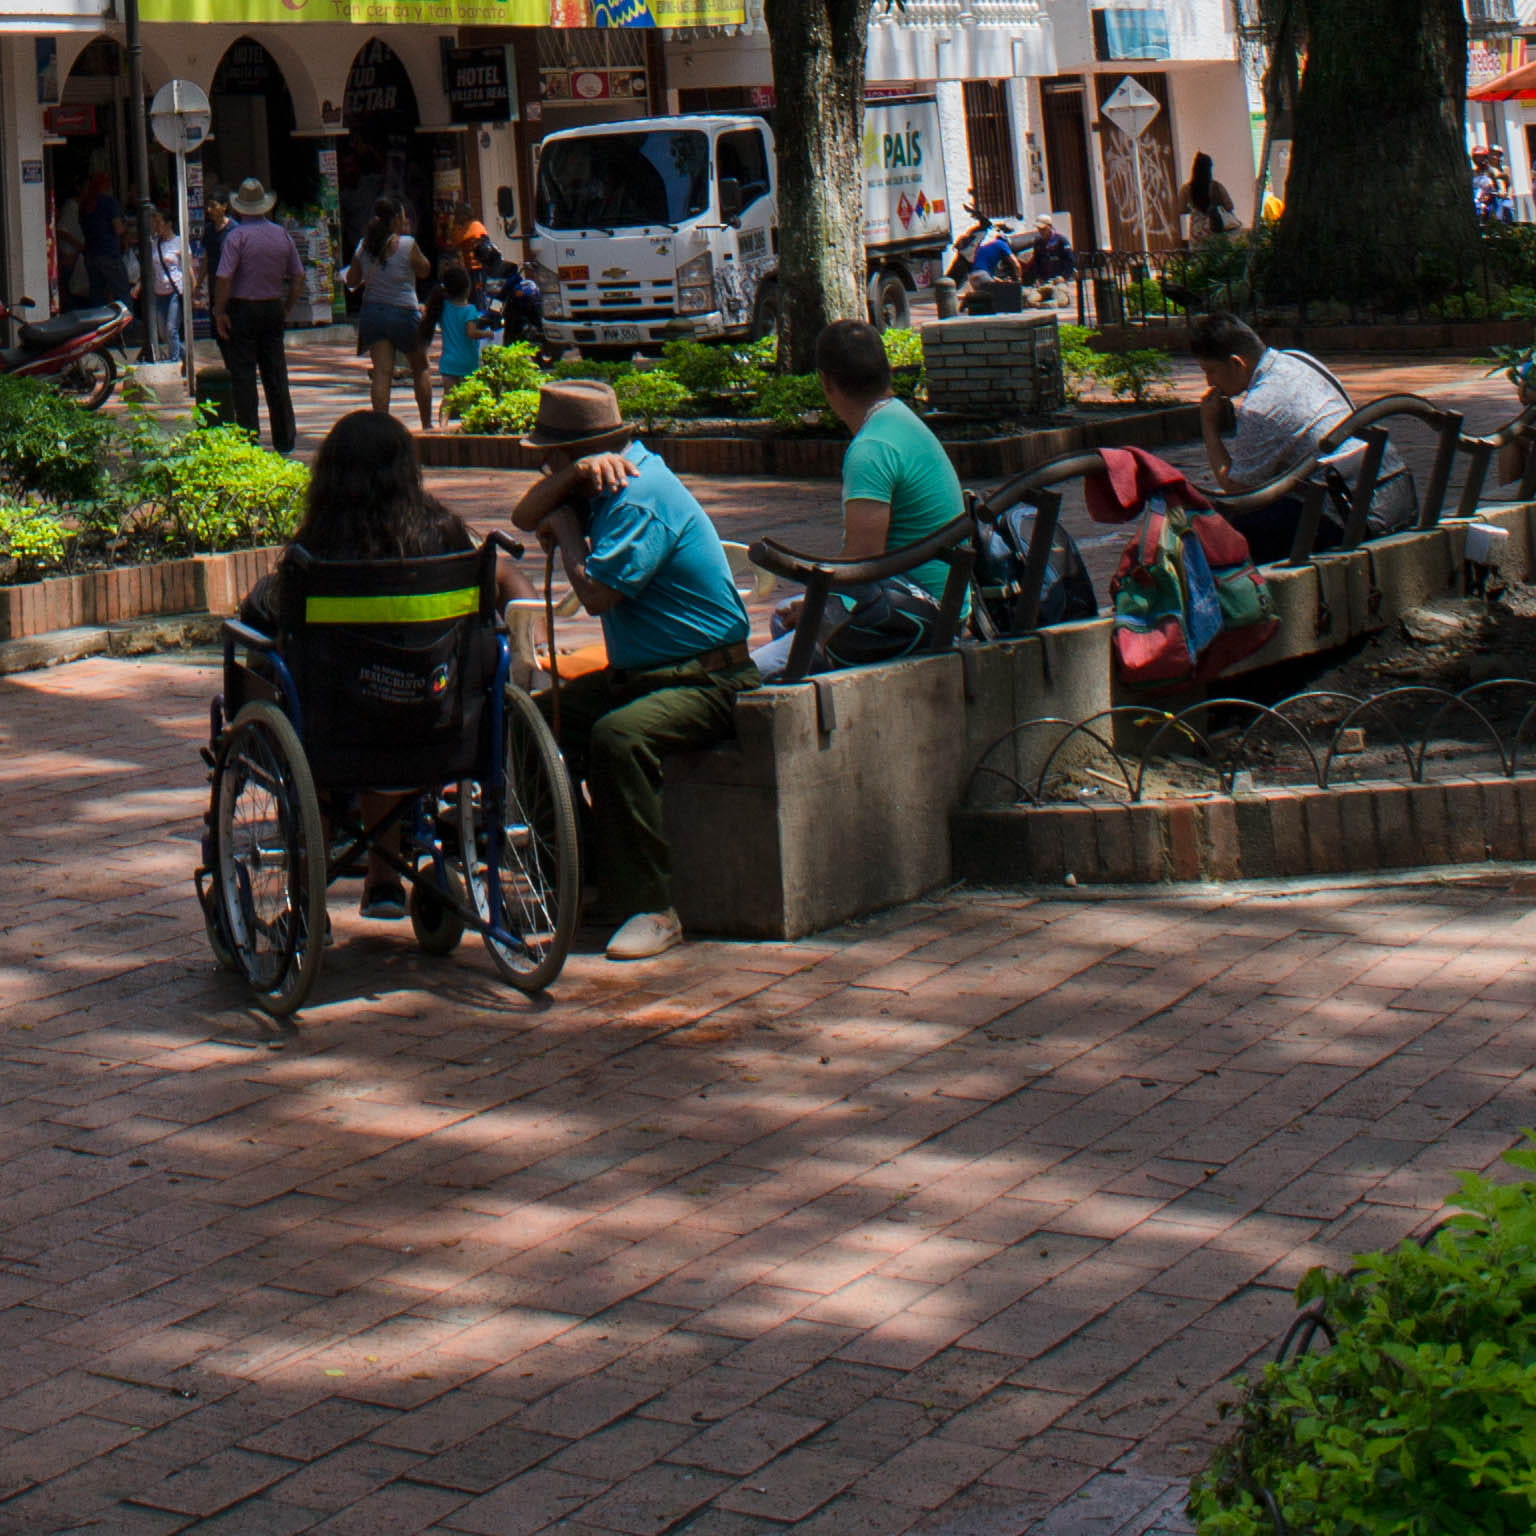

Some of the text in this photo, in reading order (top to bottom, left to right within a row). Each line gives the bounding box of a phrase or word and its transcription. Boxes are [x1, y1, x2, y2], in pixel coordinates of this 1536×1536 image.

[331, 0, 507, 21] Tan cerca y tan barato
[456, 66, 501, 88] HOTEL
[451, 88, 485, 103] VILLETA
[882, 121, 923, 169] PAÍS
